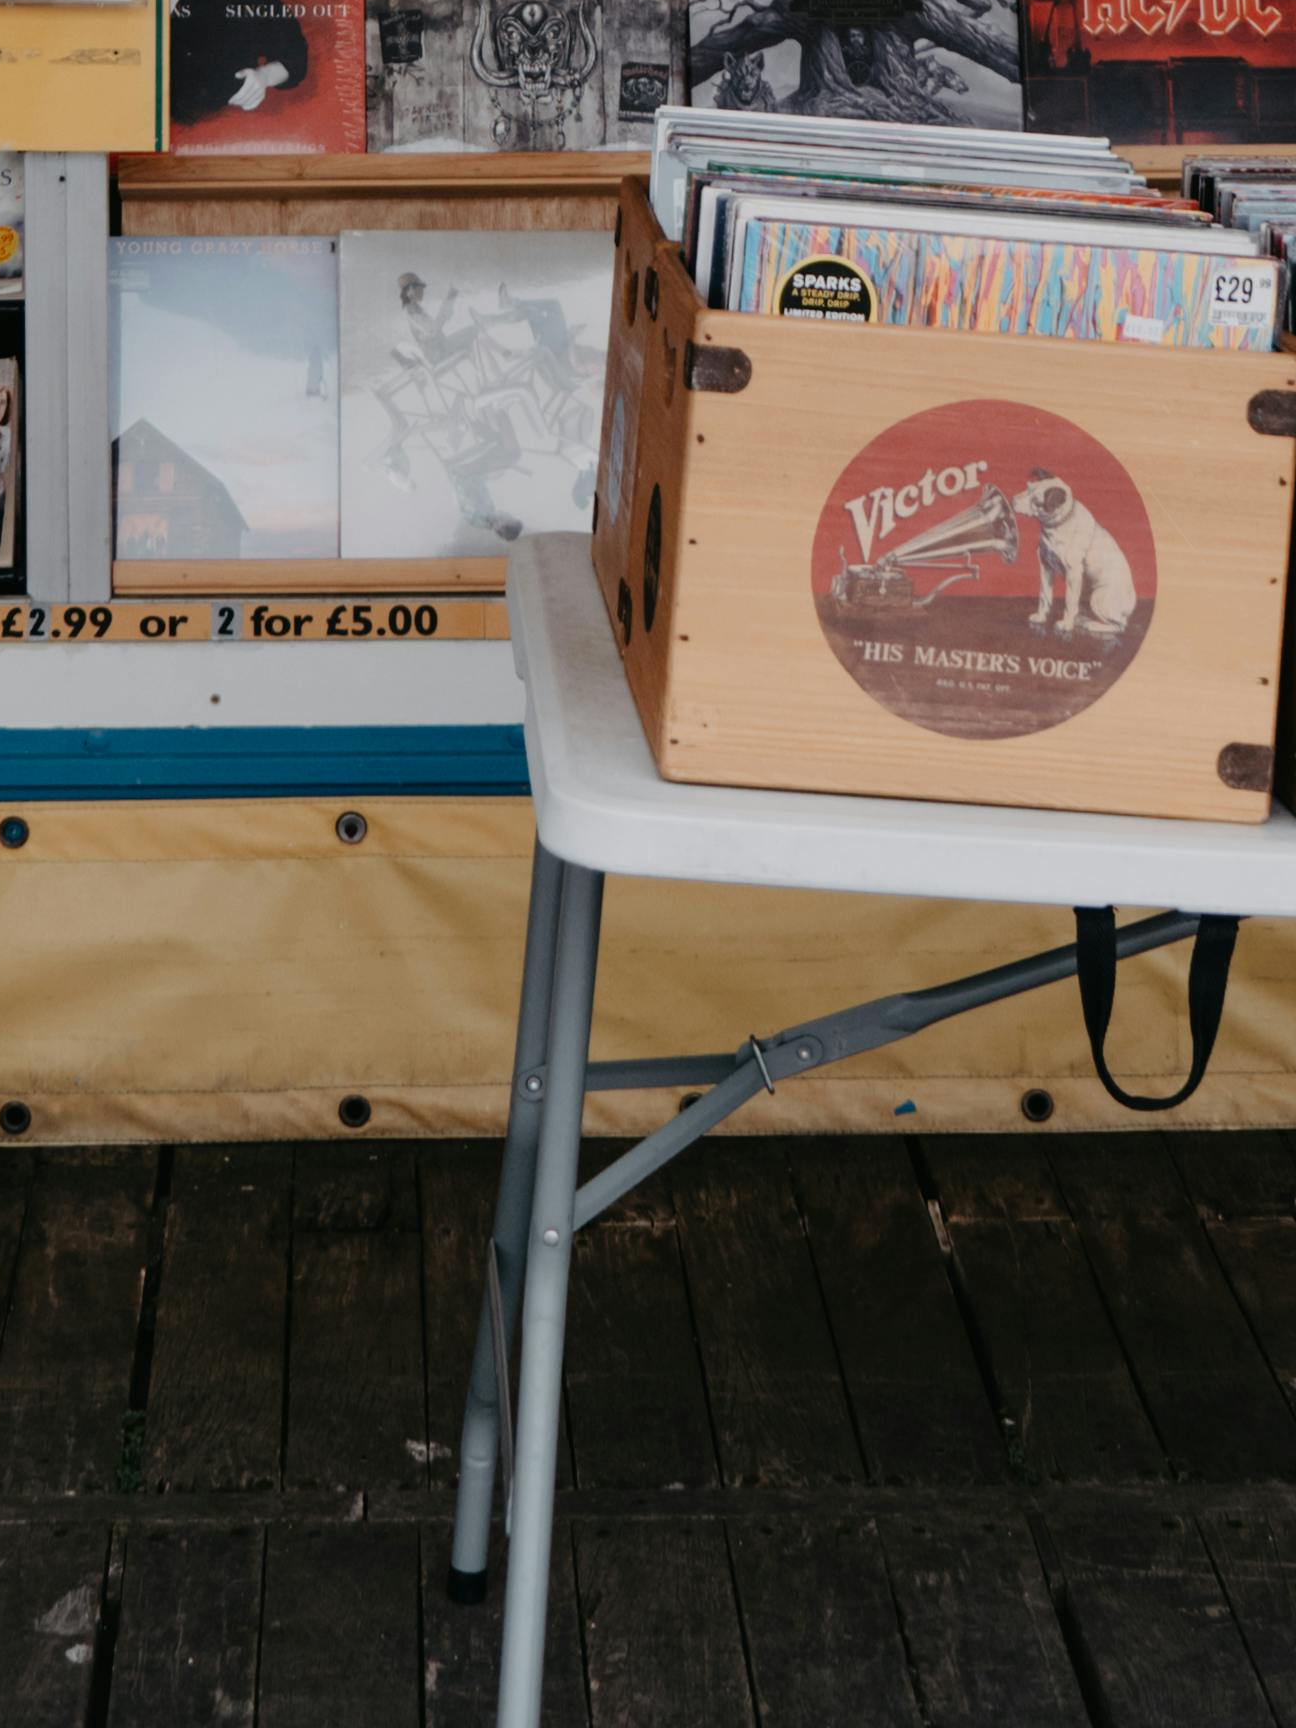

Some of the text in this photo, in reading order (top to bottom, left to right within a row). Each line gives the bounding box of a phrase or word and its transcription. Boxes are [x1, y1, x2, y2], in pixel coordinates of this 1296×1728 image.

[225, 4, 350, 19] SINGLED OUT
[792, 272, 862, 292] SPARKS
[844, 460, 988, 564] Victor
[2, 605, 439, 639] £2.99 or 2 for £5.00
[914, 646, 1021, 677] MASTER'S
